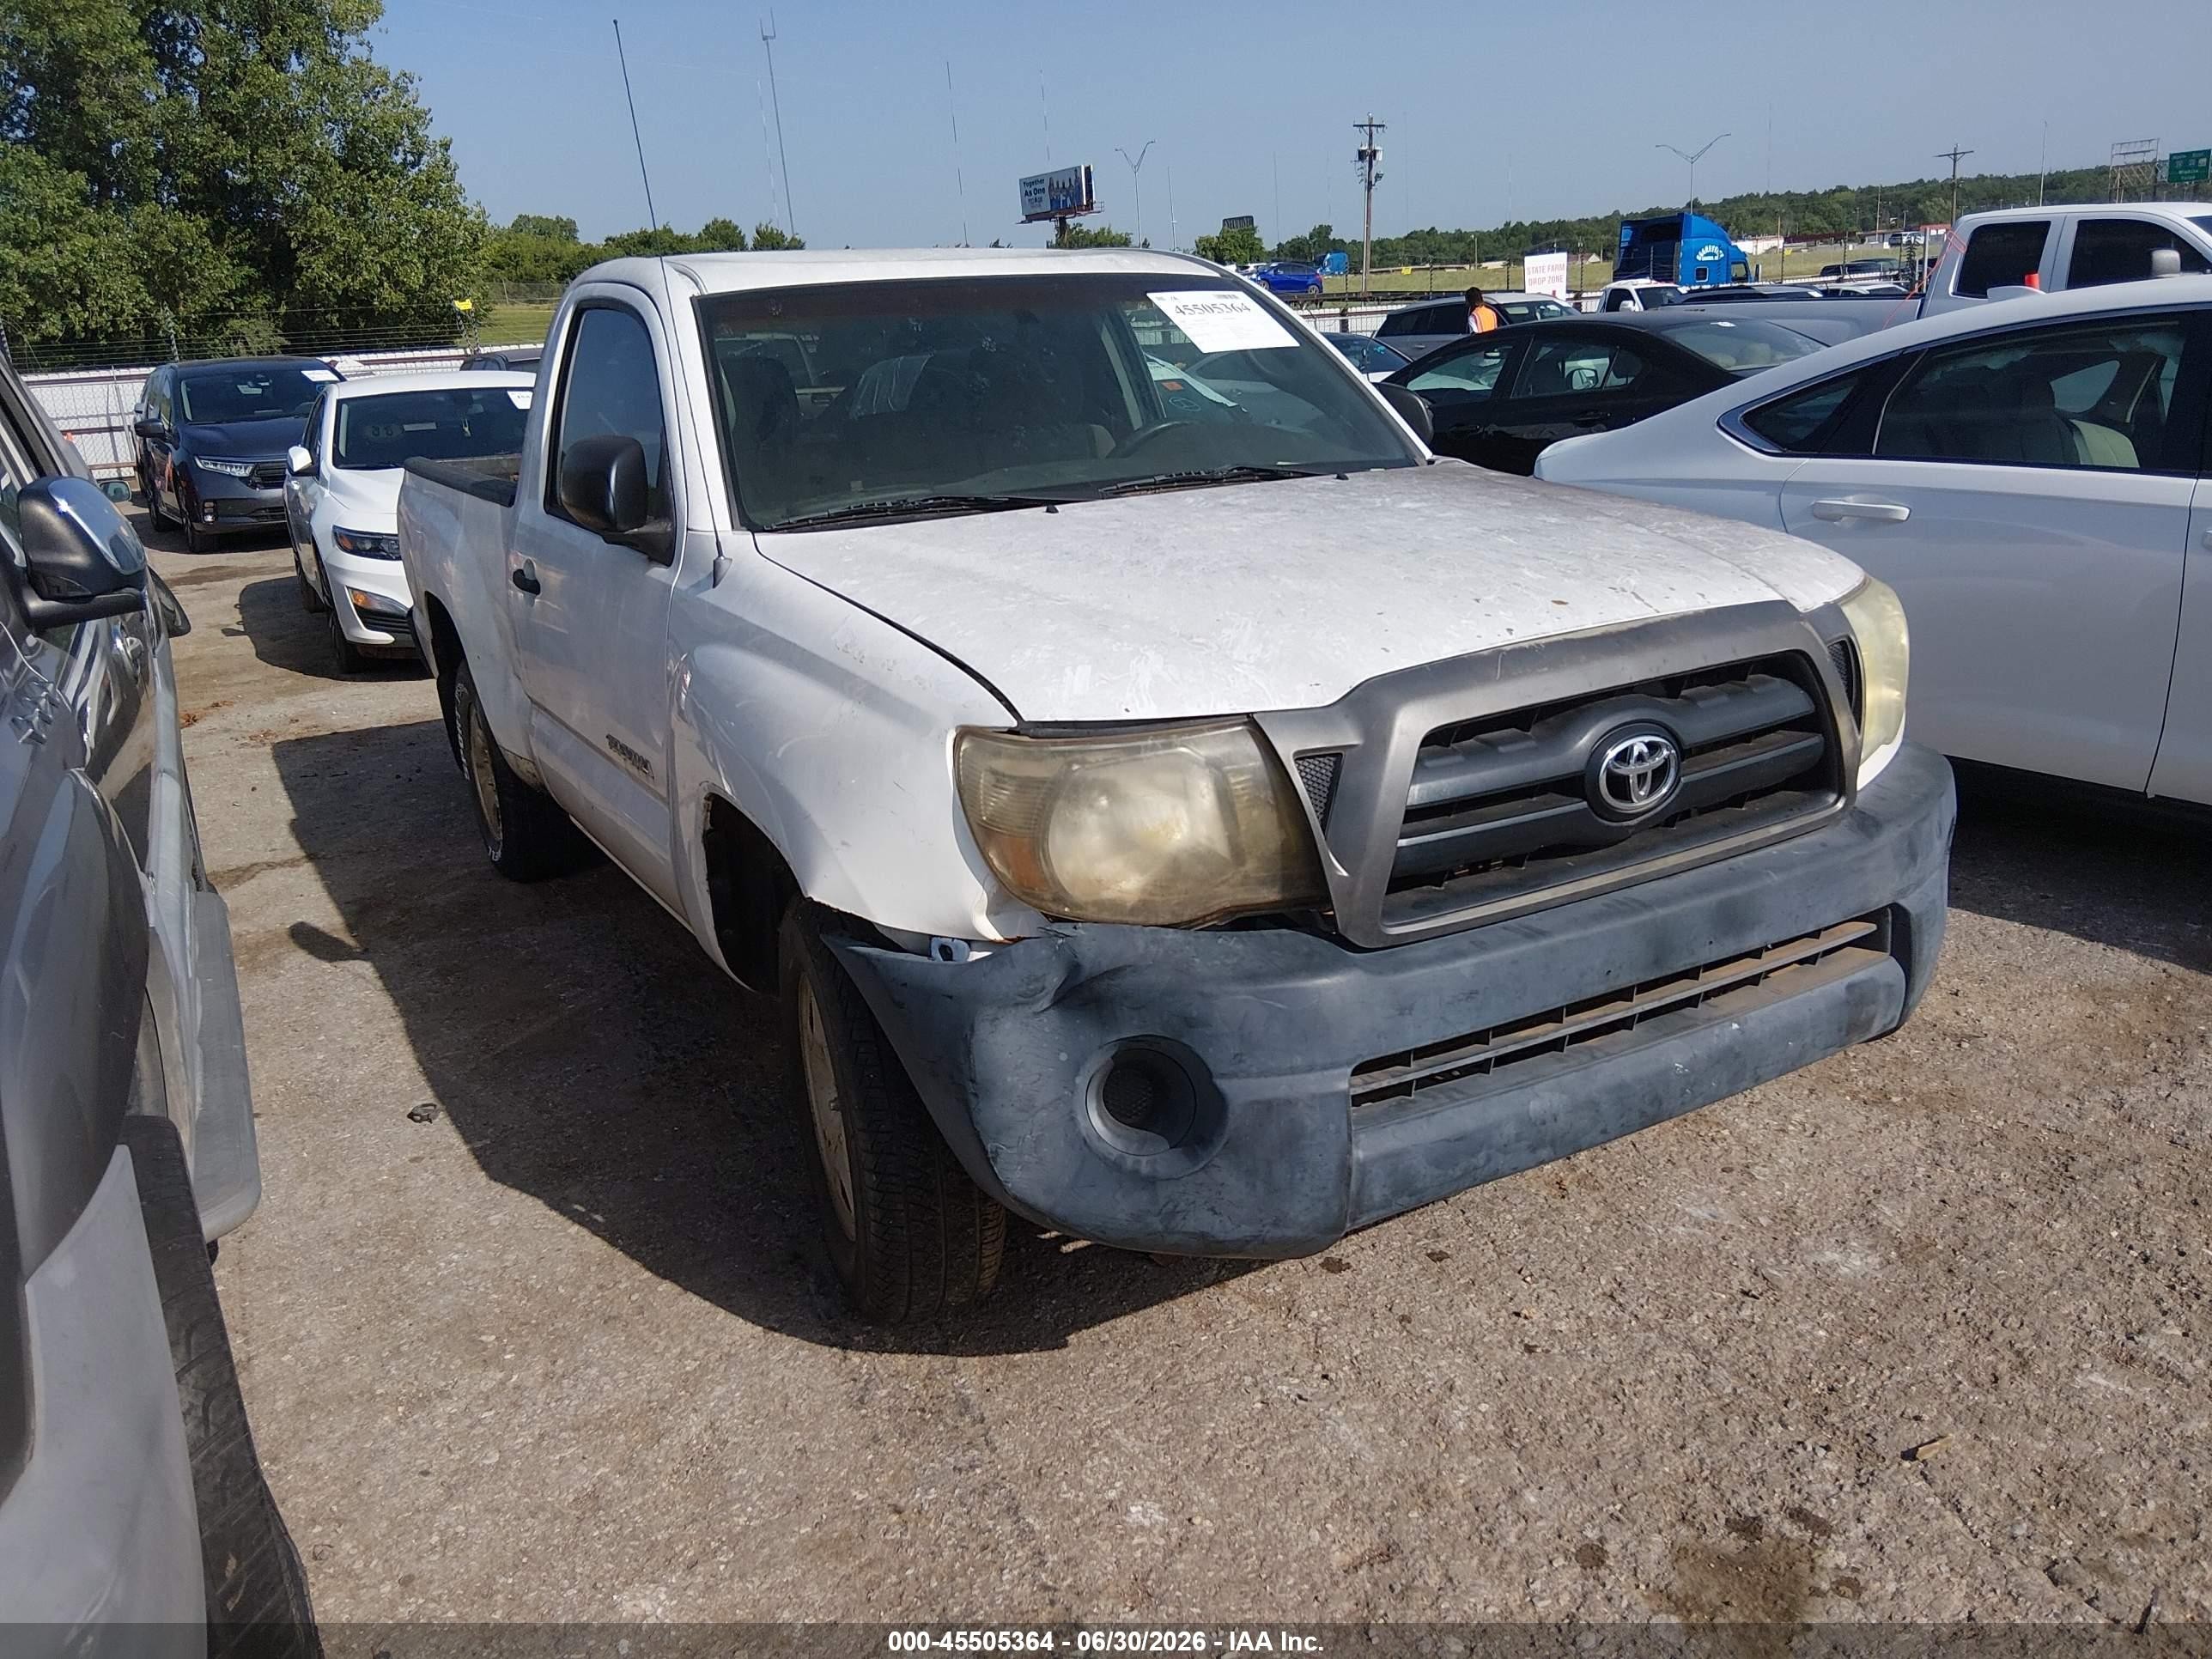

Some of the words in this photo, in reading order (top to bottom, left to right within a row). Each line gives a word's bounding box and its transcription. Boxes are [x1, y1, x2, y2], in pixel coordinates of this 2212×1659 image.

[1023, 179, 1045, 188] Together
[1024, 189, 1033, 198] As
[1033, 187, 1045, 197] One
[1527, 265, 1546, 276] STATE
[1547, 263, 1565, 273] FARM
[1528, 276, 1546, 286] DROP
[1547, 275, 1564, 284] ZONE
[1175, 302, 1251, 316] 45505364
